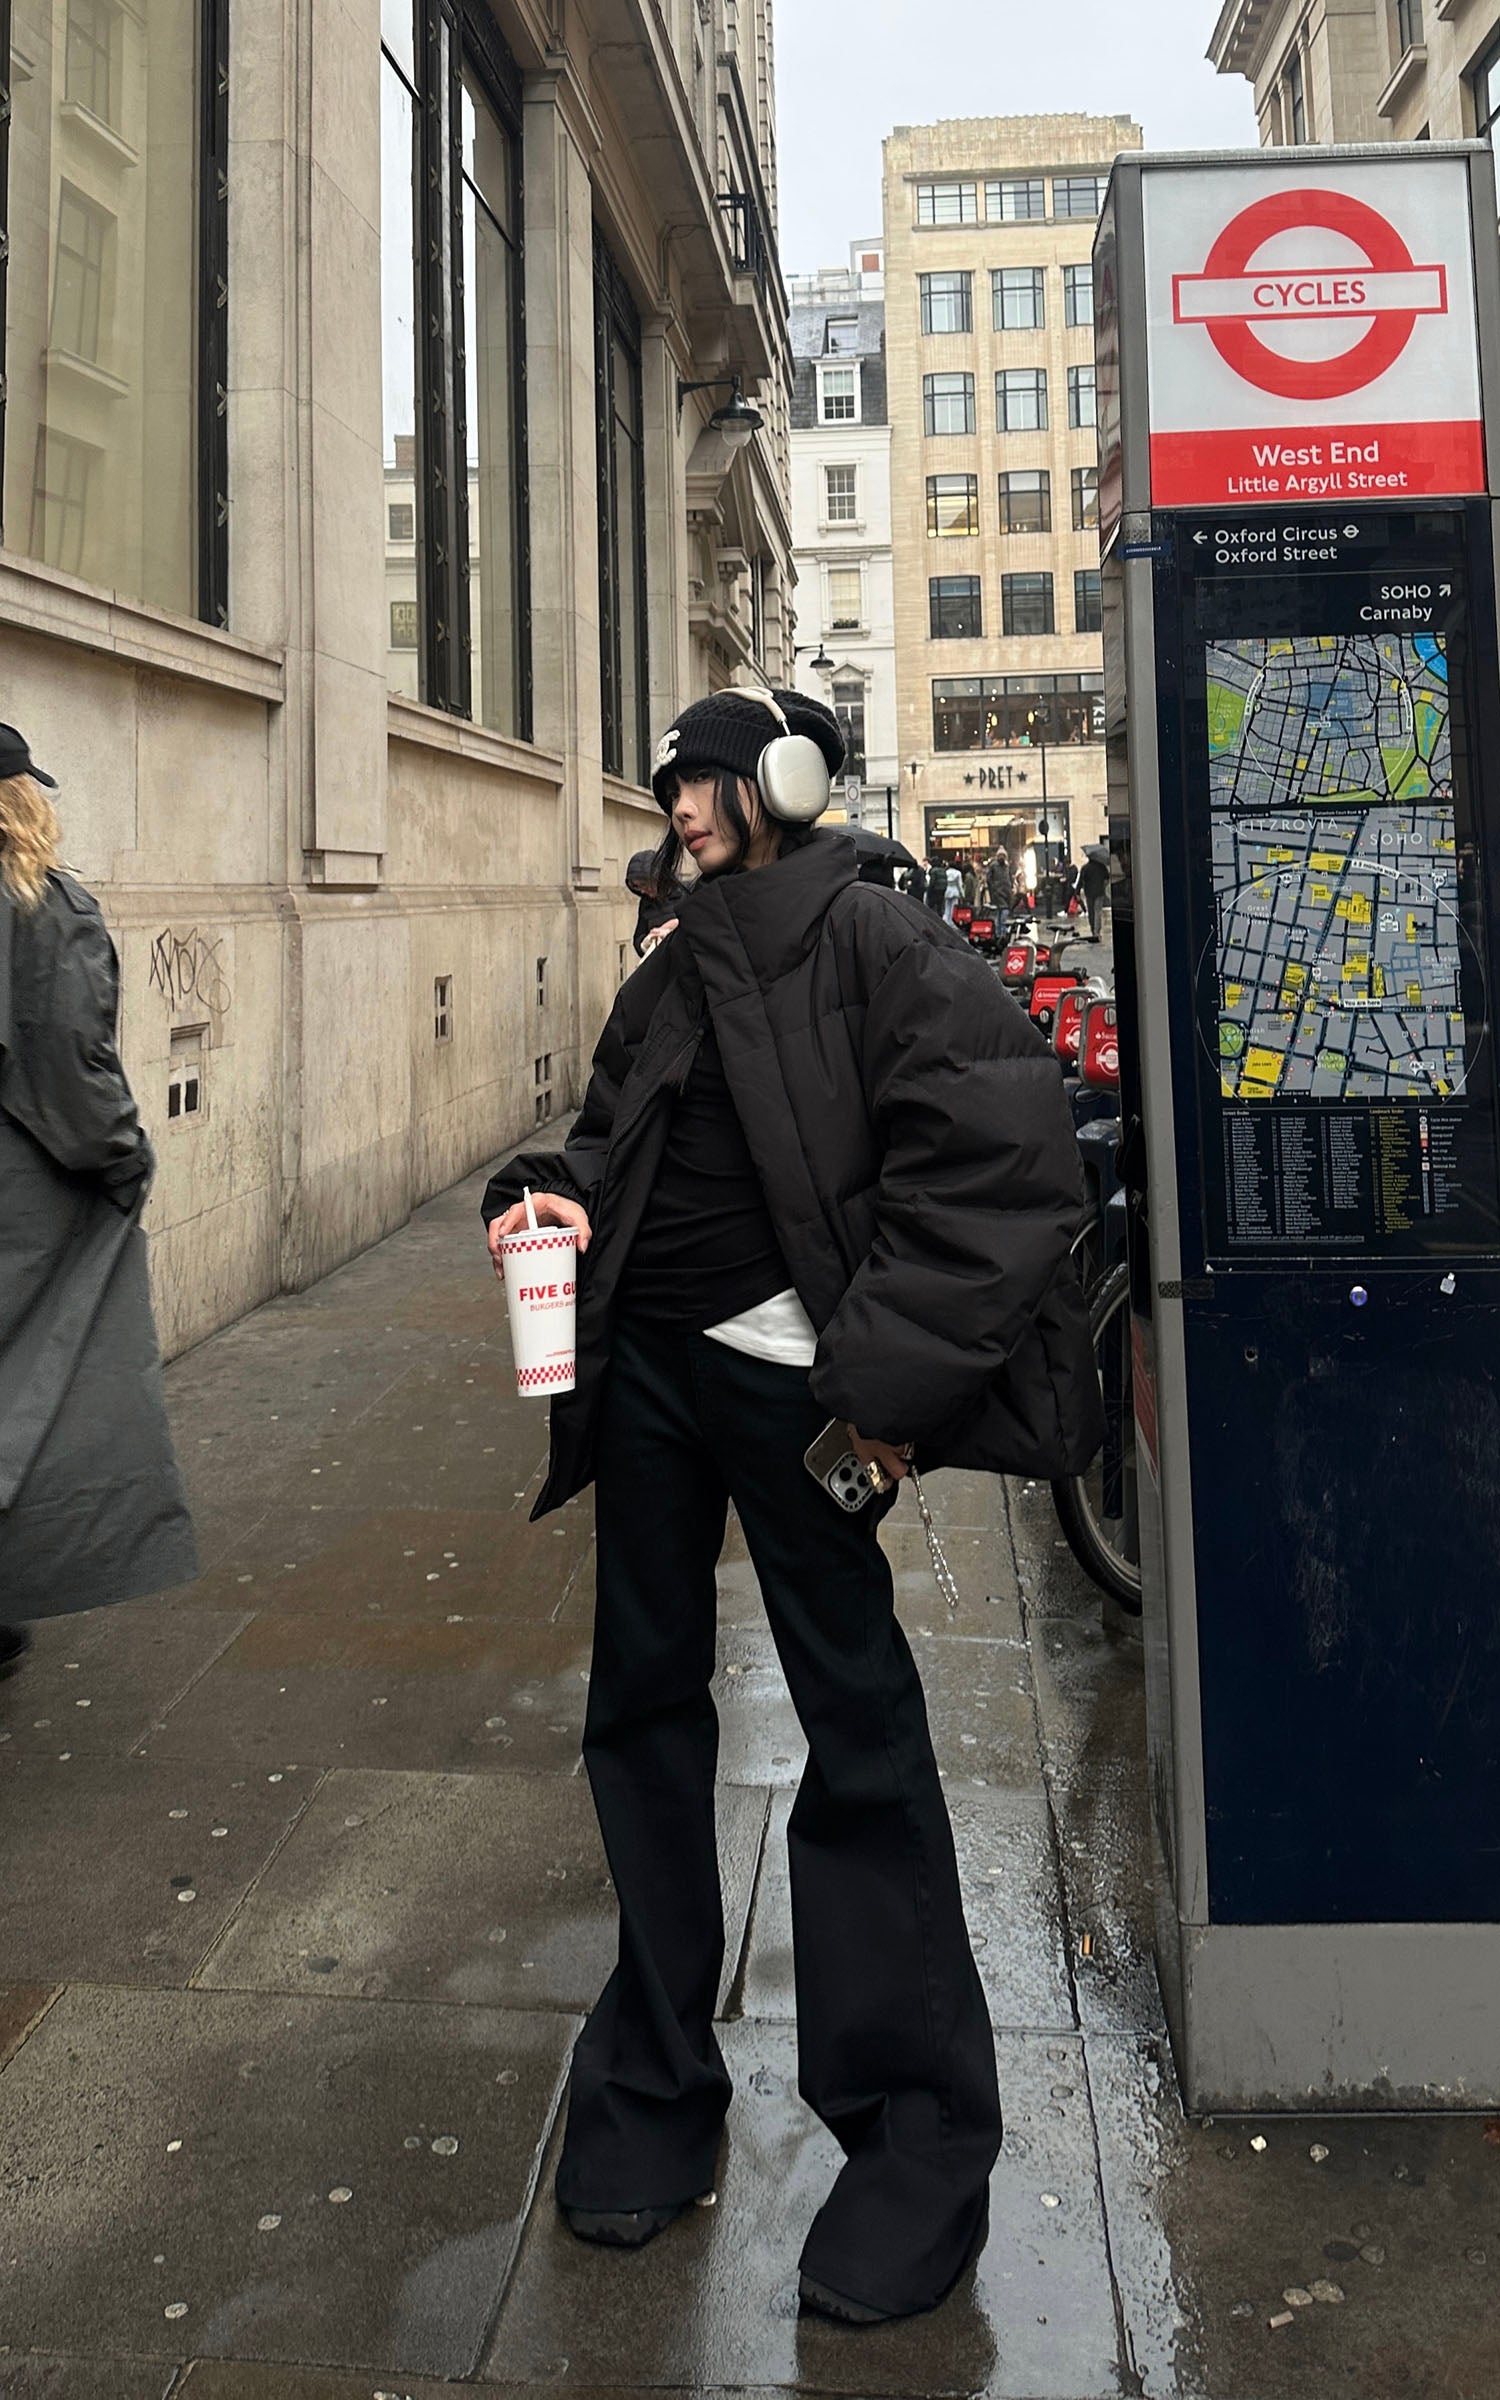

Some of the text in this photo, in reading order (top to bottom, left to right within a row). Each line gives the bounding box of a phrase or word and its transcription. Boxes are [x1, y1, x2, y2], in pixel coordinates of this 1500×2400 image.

[1253, 280, 1366, 308] CYCLES
[1252, 440, 1379, 467] West End
[1228, 470, 1407, 495] Little Argyll Street
[1214, 526, 1338, 545] Oxford Circus
[1215, 545, 1338, 563] Oxford Street
[1380, 583, 1431, 600] SOHO
[1360, 604, 1433, 623] Carnaby
[979, 765, 1013, 790] PRET
[1239, 818, 1338, 832] FITZROVIA
[1370, 832, 1423, 846] SOHO
[519, 1284, 558, 1302] FIVE
